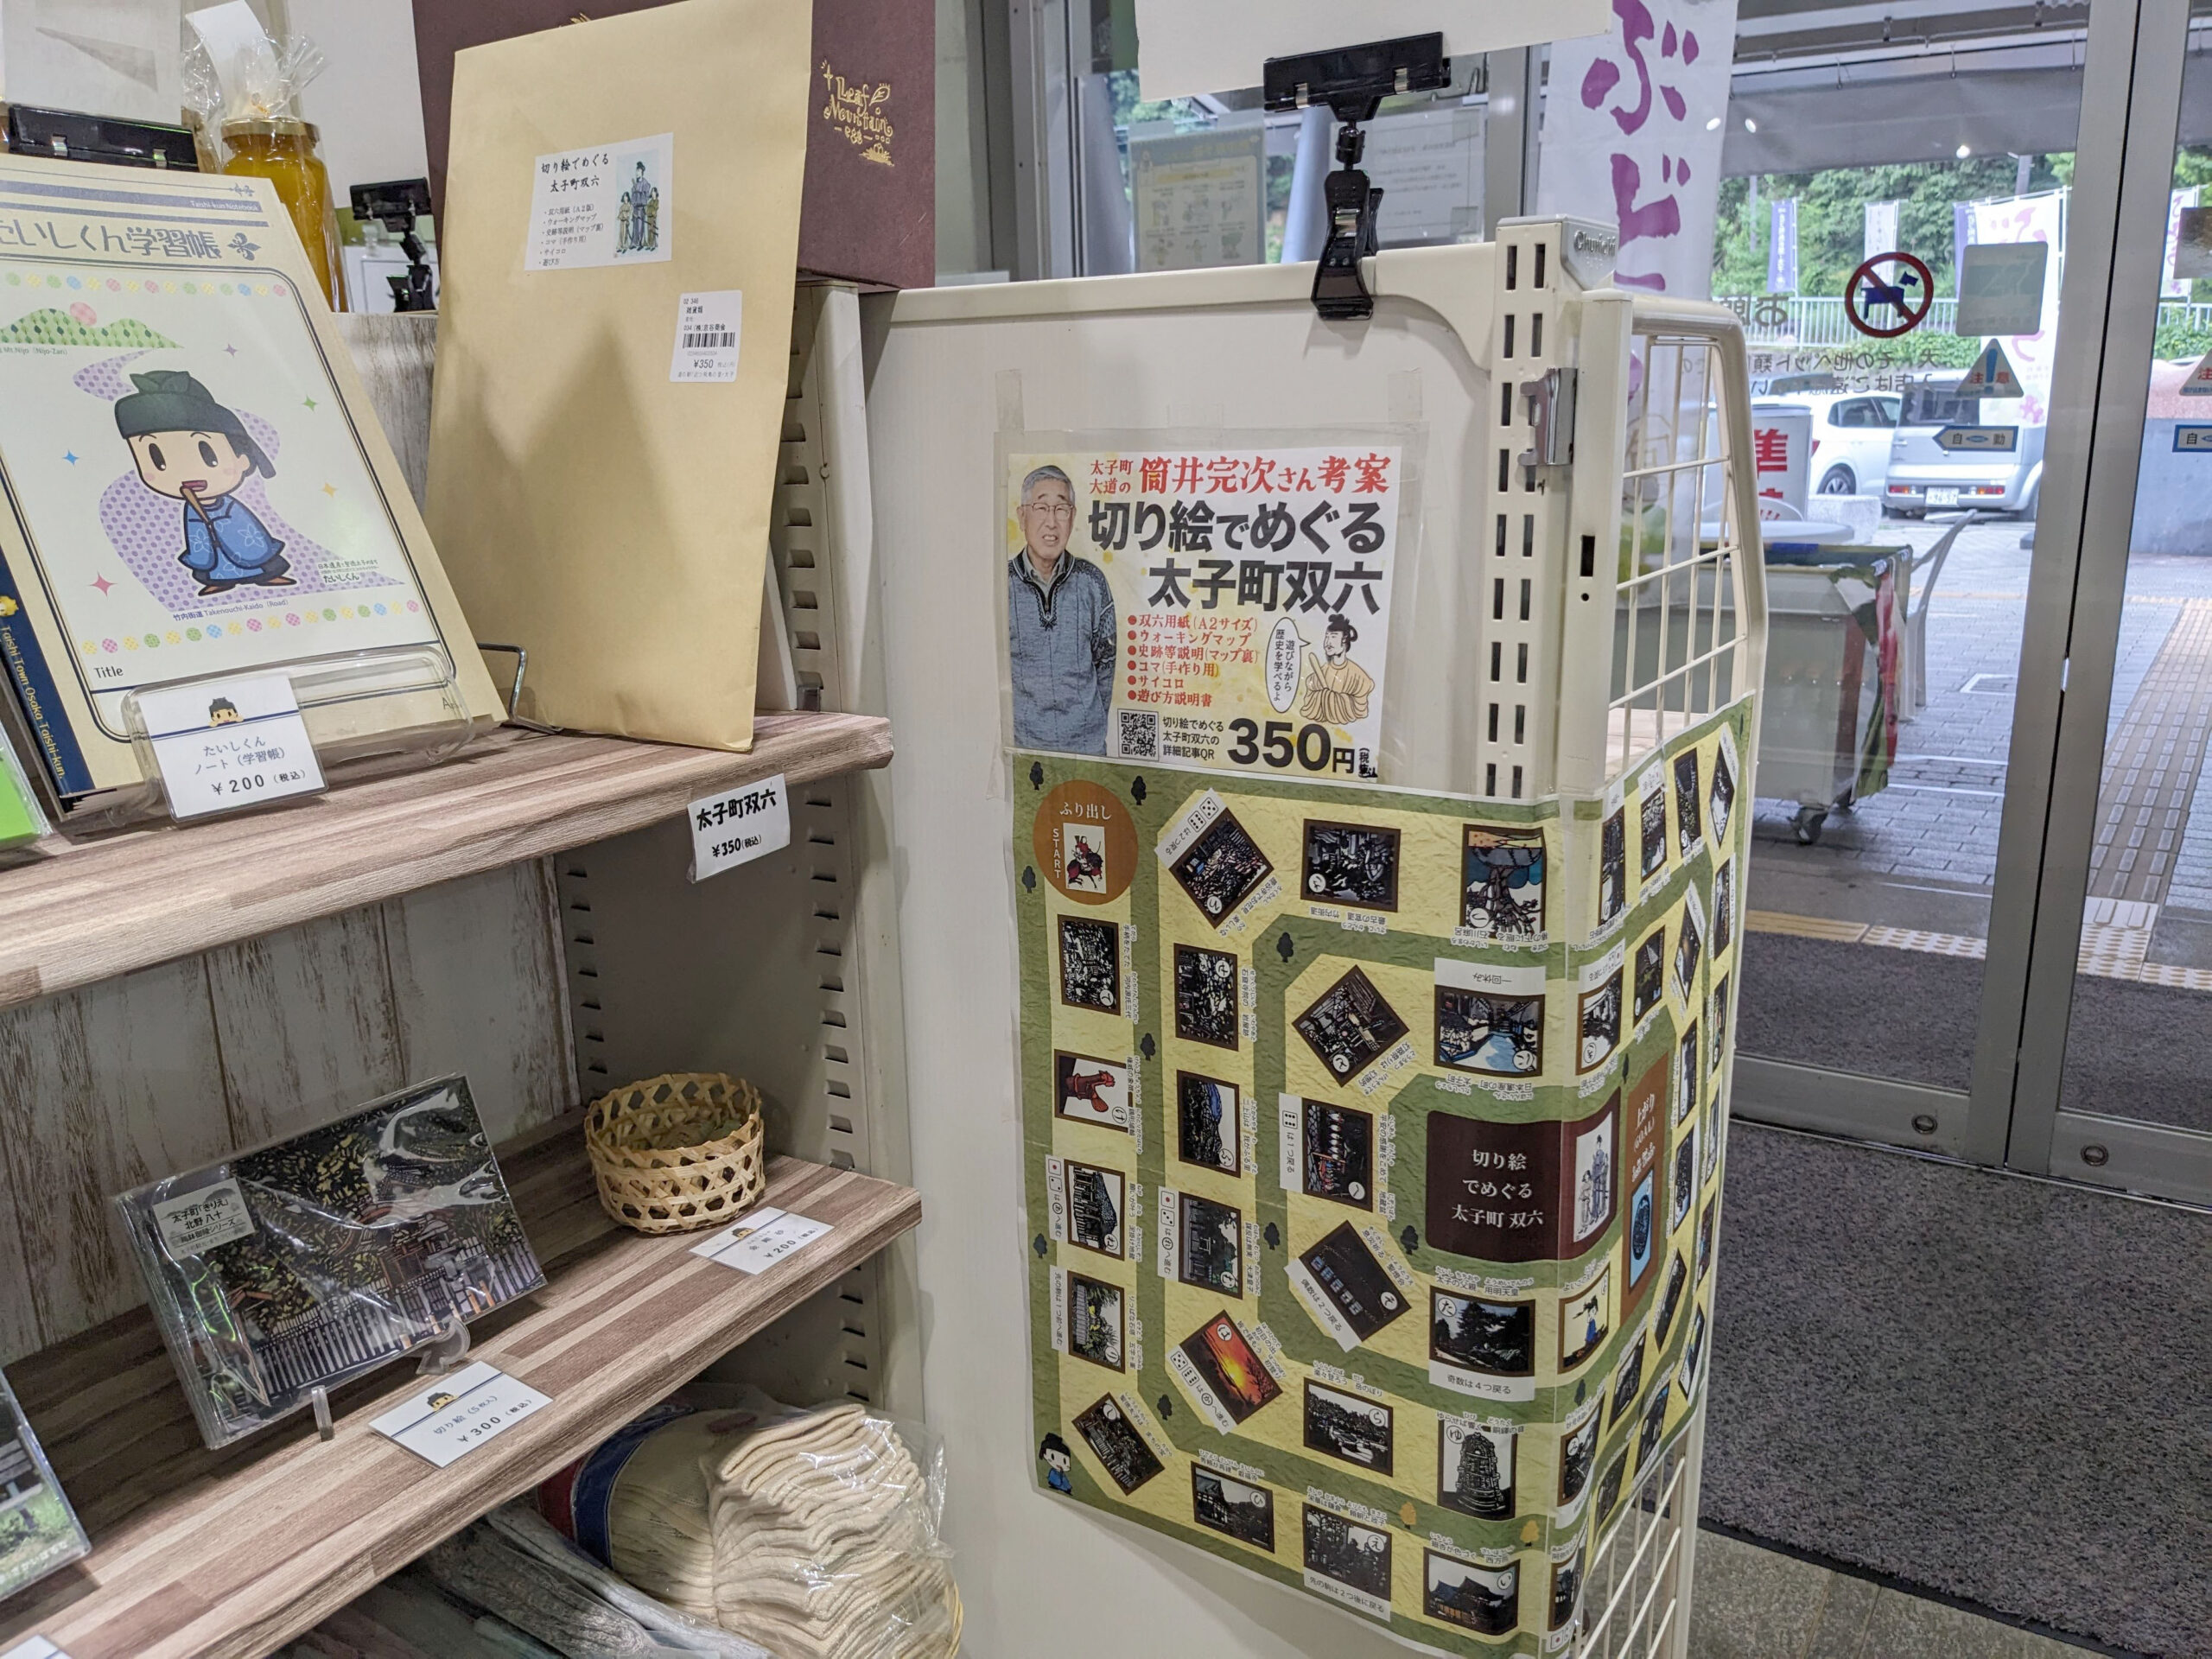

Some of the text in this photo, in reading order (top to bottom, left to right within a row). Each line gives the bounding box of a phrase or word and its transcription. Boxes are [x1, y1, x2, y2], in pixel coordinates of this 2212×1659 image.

[1580, 0, 1700, 292] ぶど
[541, 154, 609, 175] 切り絵でめぐる
[550, 175, 601, 194] 太子町双六
[1090, 460, 1134, 476] 太子町
[1139, 453, 1391, 494] 筒井完次さん考案
[1090, 480, 1131, 494] 大道の
[1088, 499, 1385, 555] 切り絵でめぐる
[323, 572, 360, 584] たいしくん
[1147, 558, 1383, 615] 太子町双六
[1140, 630, 1252, 646] ウォーキングマップ
[93, 665, 124, 679] Title
[1273, 628, 1286, 702] 歴史を学べるよ
[1283, 639, 1296, 692] 遊びながら
[14, 657, 30, 686] Town
[25, 687, 44, 721] Osaka
[1137, 676, 1184, 690] サイコロ
[1137, 690, 1212, 708] 遊び方説明書
[1162, 715, 1224, 733] 切り絵でめぐる
[203, 735, 267, 758] たいしくん
[1162, 731, 1220, 746] 太子町双六の
[1227, 717, 1356, 774] 350円
[1162, 745, 1215, 760] 詳細記事QR
[696, 788, 777, 832] 太子町双六
[1058, 802, 1113, 821] ふり出し
[1052, 828, 1062, 879] START
[1471, 1148, 1527, 1172] 切り絵
[1462, 1178, 1533, 1200] でめぐる
[1452, 1206, 1544, 1230] 太子町 双六
[1446, 1375, 1511, 1395] 奇数は4つ戻る
